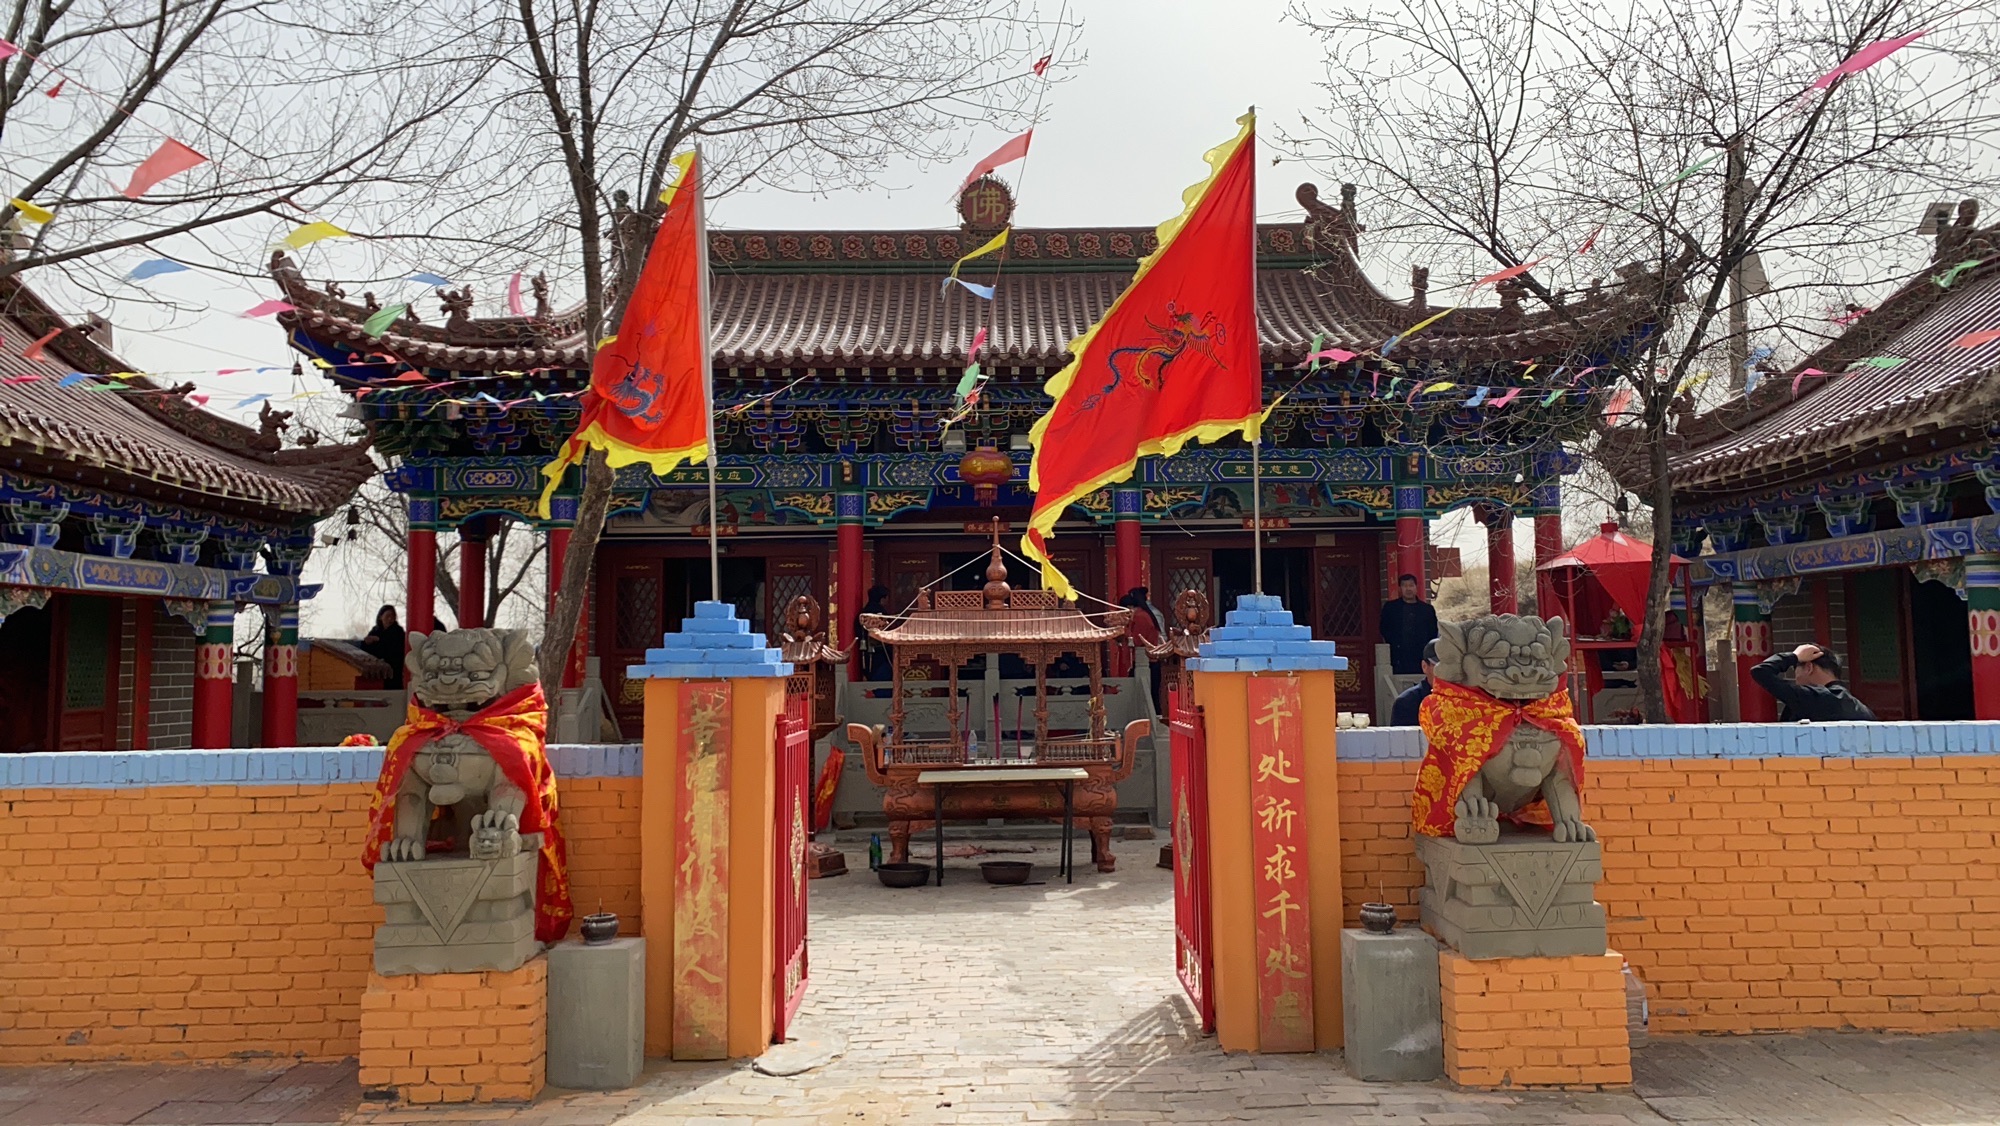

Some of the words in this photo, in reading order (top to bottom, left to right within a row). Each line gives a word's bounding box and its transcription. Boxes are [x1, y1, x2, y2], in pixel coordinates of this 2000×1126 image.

[967, 188, 1005, 223] 佛
[673, 470, 741, 481] 有求必应
